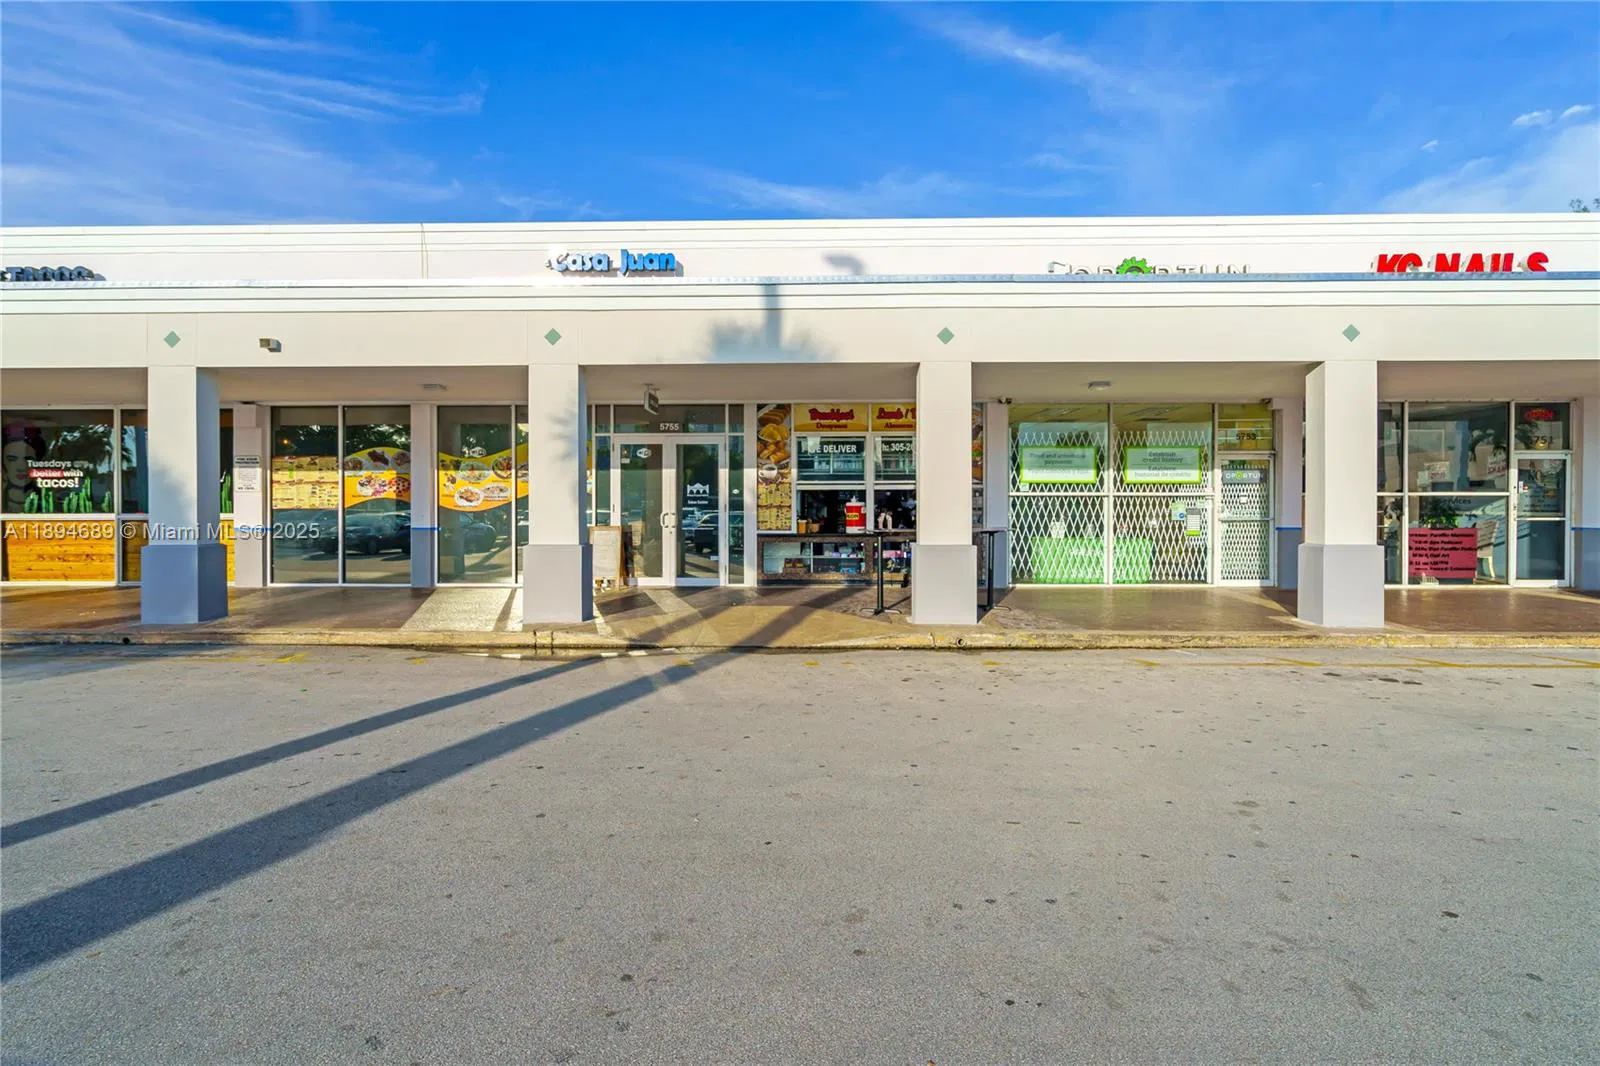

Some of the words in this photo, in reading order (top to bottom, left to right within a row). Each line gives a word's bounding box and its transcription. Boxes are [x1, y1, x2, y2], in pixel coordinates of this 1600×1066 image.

[546, 252, 610, 271] Casa
[620, 249, 676, 275] Juan
[659, 422, 680, 431] 5755
[823, 444, 857, 453] DELIVER
[27, 460, 72, 469] Tuesdays
[63, 469, 83, 477] with
[36, 478, 79, 488] tacos!
